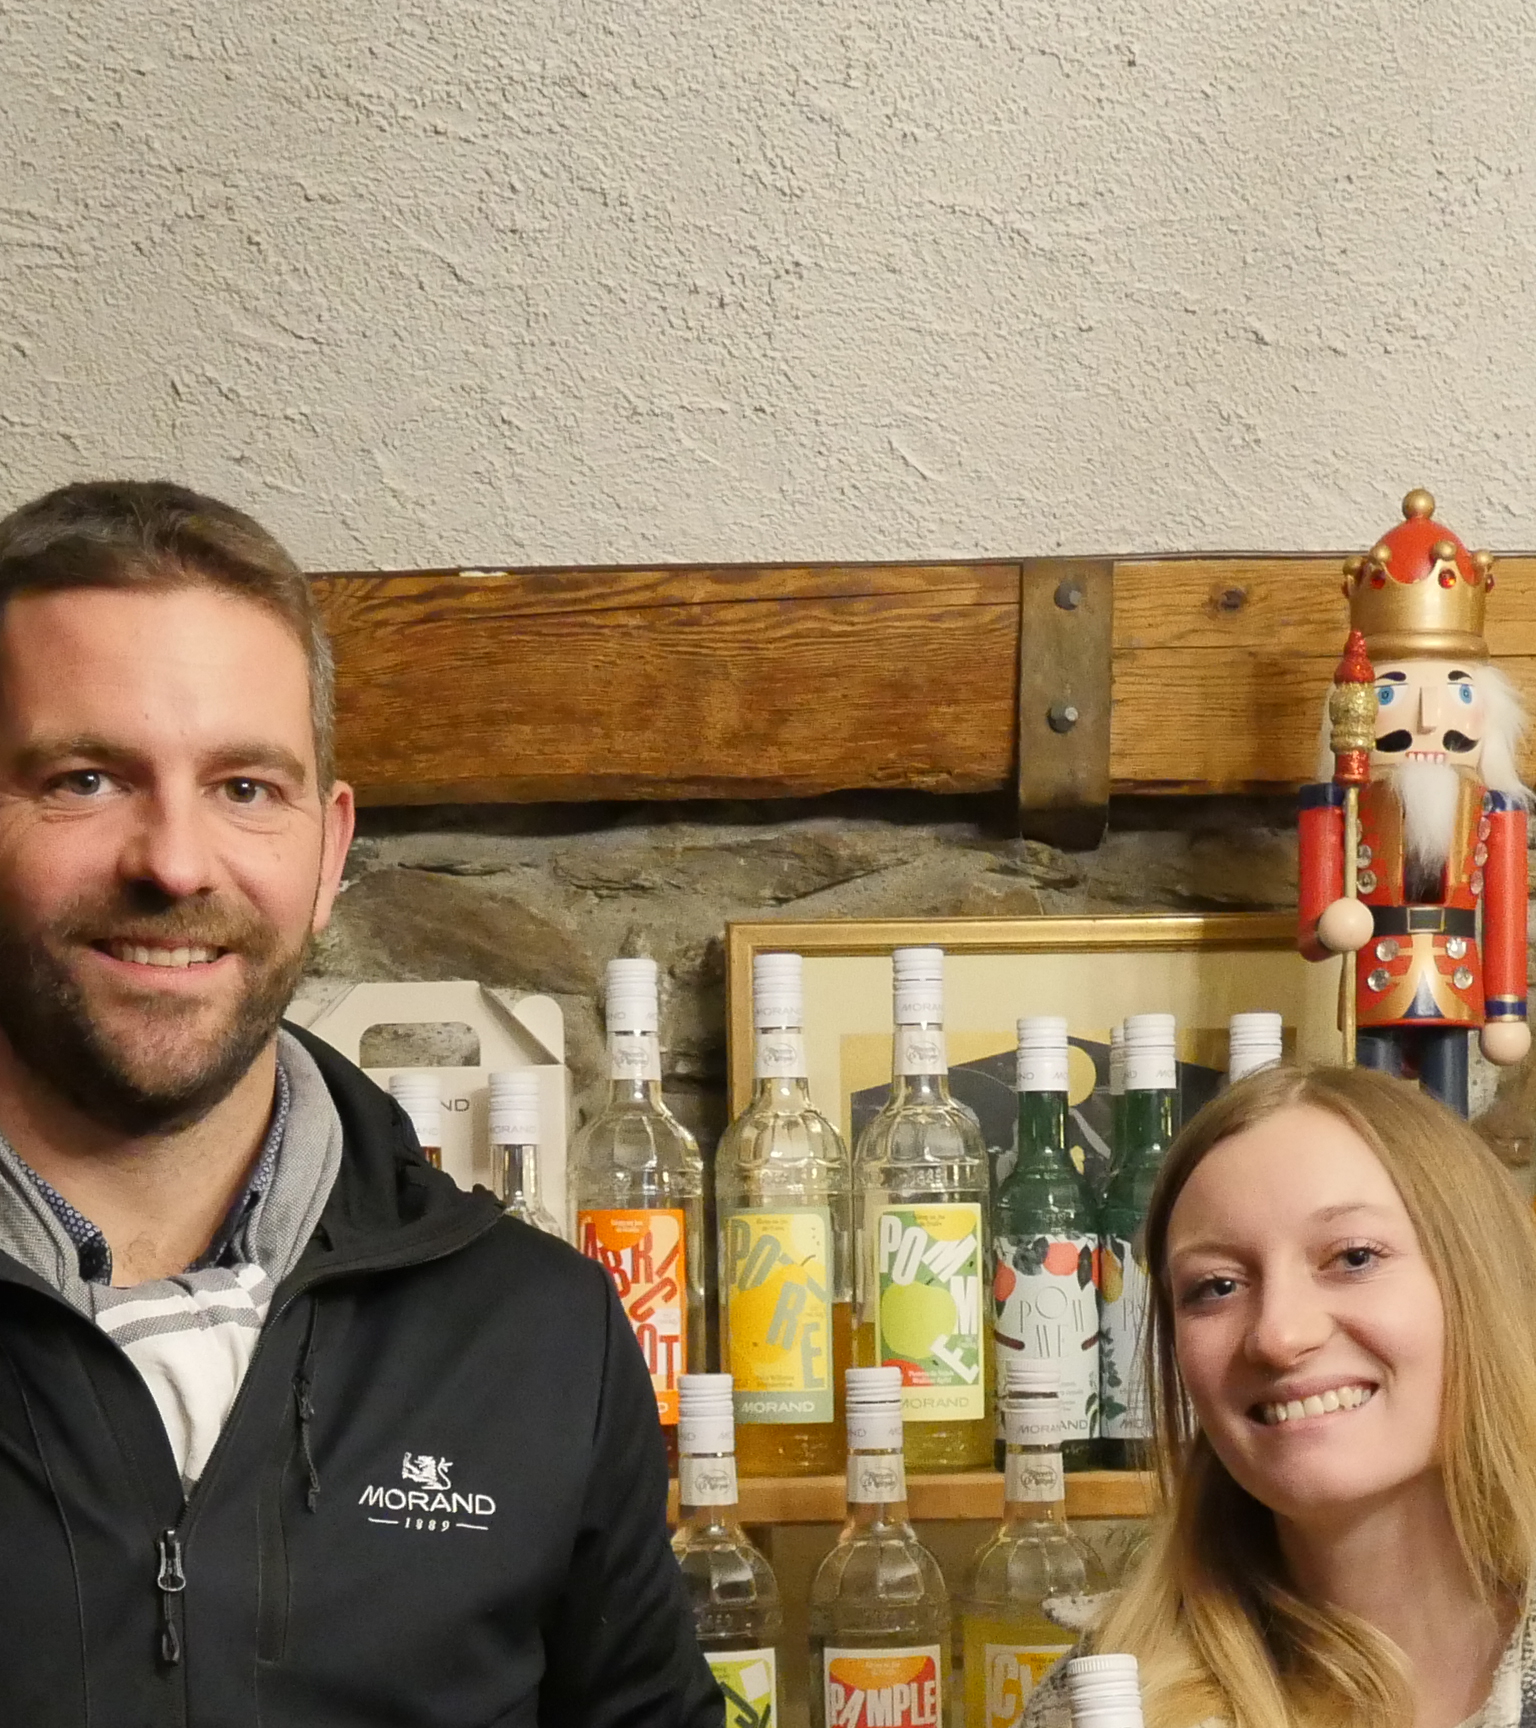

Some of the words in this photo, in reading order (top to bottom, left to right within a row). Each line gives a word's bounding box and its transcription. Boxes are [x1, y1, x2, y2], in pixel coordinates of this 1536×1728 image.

[901, 1002, 943, 1012] MORAN
[741, 1400, 815, 1414] MORAND
[358, 1485, 496, 1515] MORAND
[404, 1517, 450, 1532] 1889
